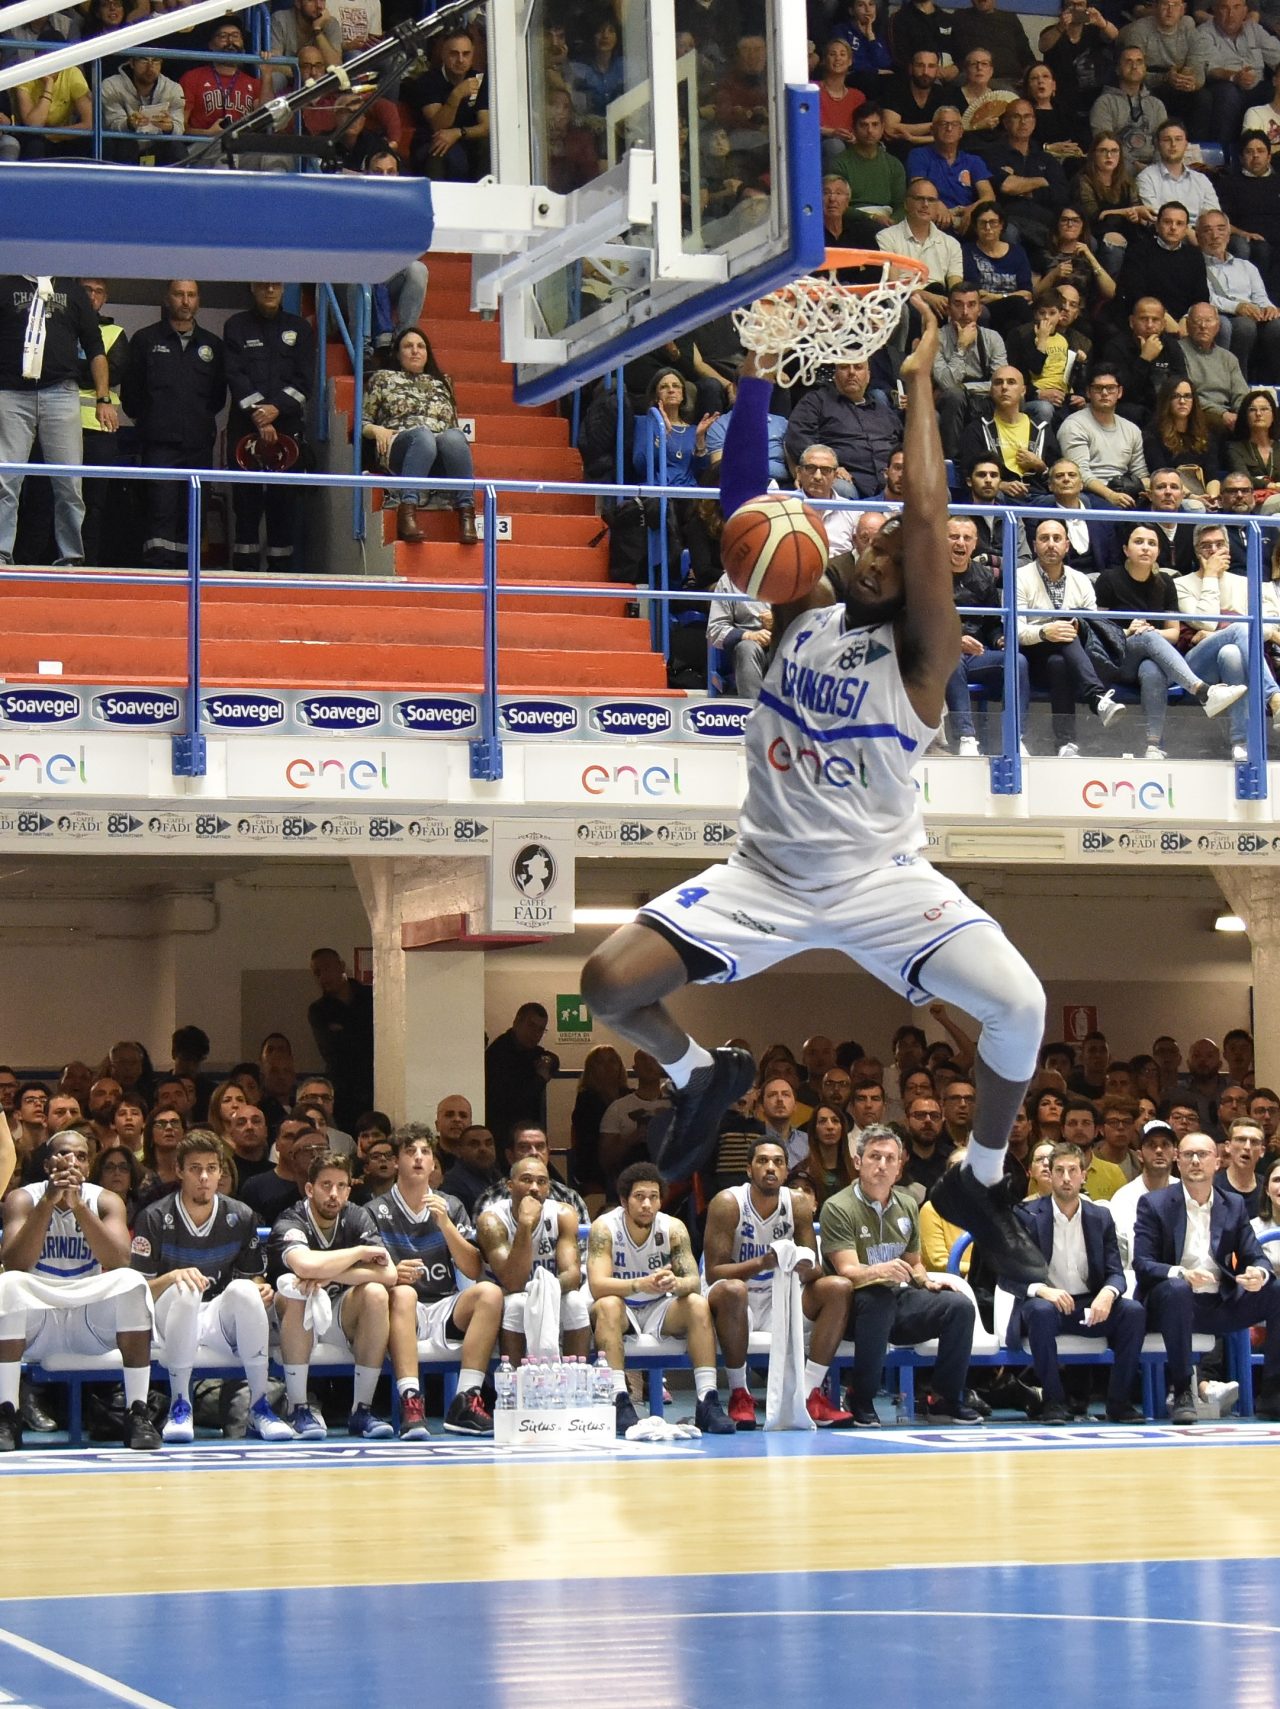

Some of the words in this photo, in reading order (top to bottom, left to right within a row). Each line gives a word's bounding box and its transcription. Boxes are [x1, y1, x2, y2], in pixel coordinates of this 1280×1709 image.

[203, 89, 254, 116] BULLS
[462, 423, 472, 435] 4
[498, 520, 509, 533] 3
[839, 645, 867, 671] 85
[6, 696, 78, 717] Soavegel
[106, 697, 177, 718] Soavegel
[212, 700, 282, 721] Soavegel
[309, 702, 380, 723] Soavegel
[406, 704, 475, 725] Soavegel
[508, 707, 577, 728] Soavegel
[602, 708, 671, 729] Soavegel
[697, 710, 749, 731] Soaveg
[286, 751, 390, 789] enel
[769, 736, 869, 789] enel
[581, 757, 682, 795] enel
[1082, 773, 1176, 810] enel
[18, 814, 38, 832] 85
[72, 822, 100, 832] FADI
[107, 815, 128, 834] 85
[162, 824, 190, 832] FADI
[196, 817, 216, 835] 85
[252, 825, 279, 834] FADI
[282, 818, 303, 836] 85
[335, 826, 362, 835] FADI
[369, 820, 389, 838] 85
[422, 827, 449, 836] FADI
[454, 820, 474, 838] 85
[591, 830, 617, 840] FADI
[620, 824, 640, 842] 85
[671, 831, 697, 840] FADI
[703, 825, 722, 842] 85
[1083, 832, 1100, 849] 85
[1160, 833, 1178, 850] 85
[1131, 839, 1156, 848] FADI
[1210, 841, 1235, 850] FADI
[1238, 835, 1256, 852] 85
[514, 906, 552, 920] FADI
[648, 1255, 662, 1270] 85
